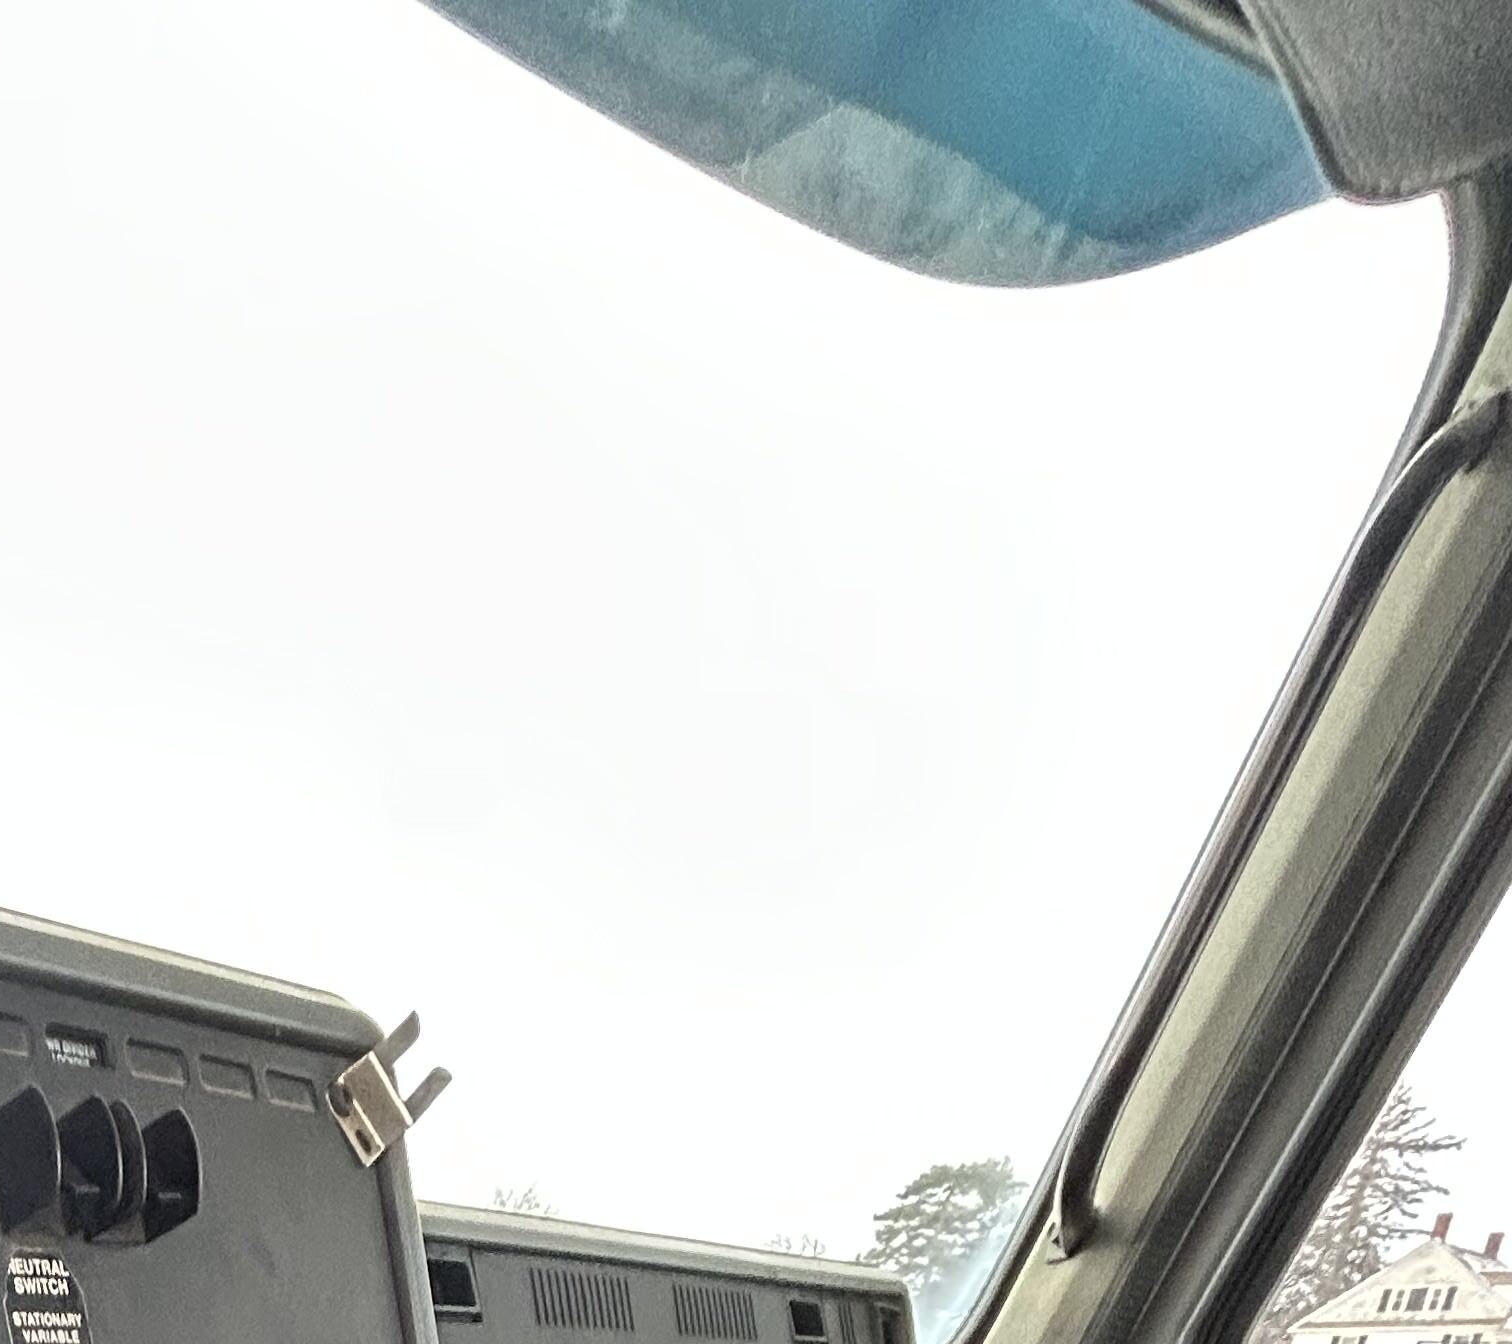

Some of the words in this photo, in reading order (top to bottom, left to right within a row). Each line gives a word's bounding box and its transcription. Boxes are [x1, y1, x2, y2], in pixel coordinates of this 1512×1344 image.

[8, 1257, 69, 1276] NEUTRAL
[13, 1276, 69, 1295] SWITCH
[12, 1311, 82, 1327] STATIONARY
[22, 1329, 80, 1344] VARIABLE
